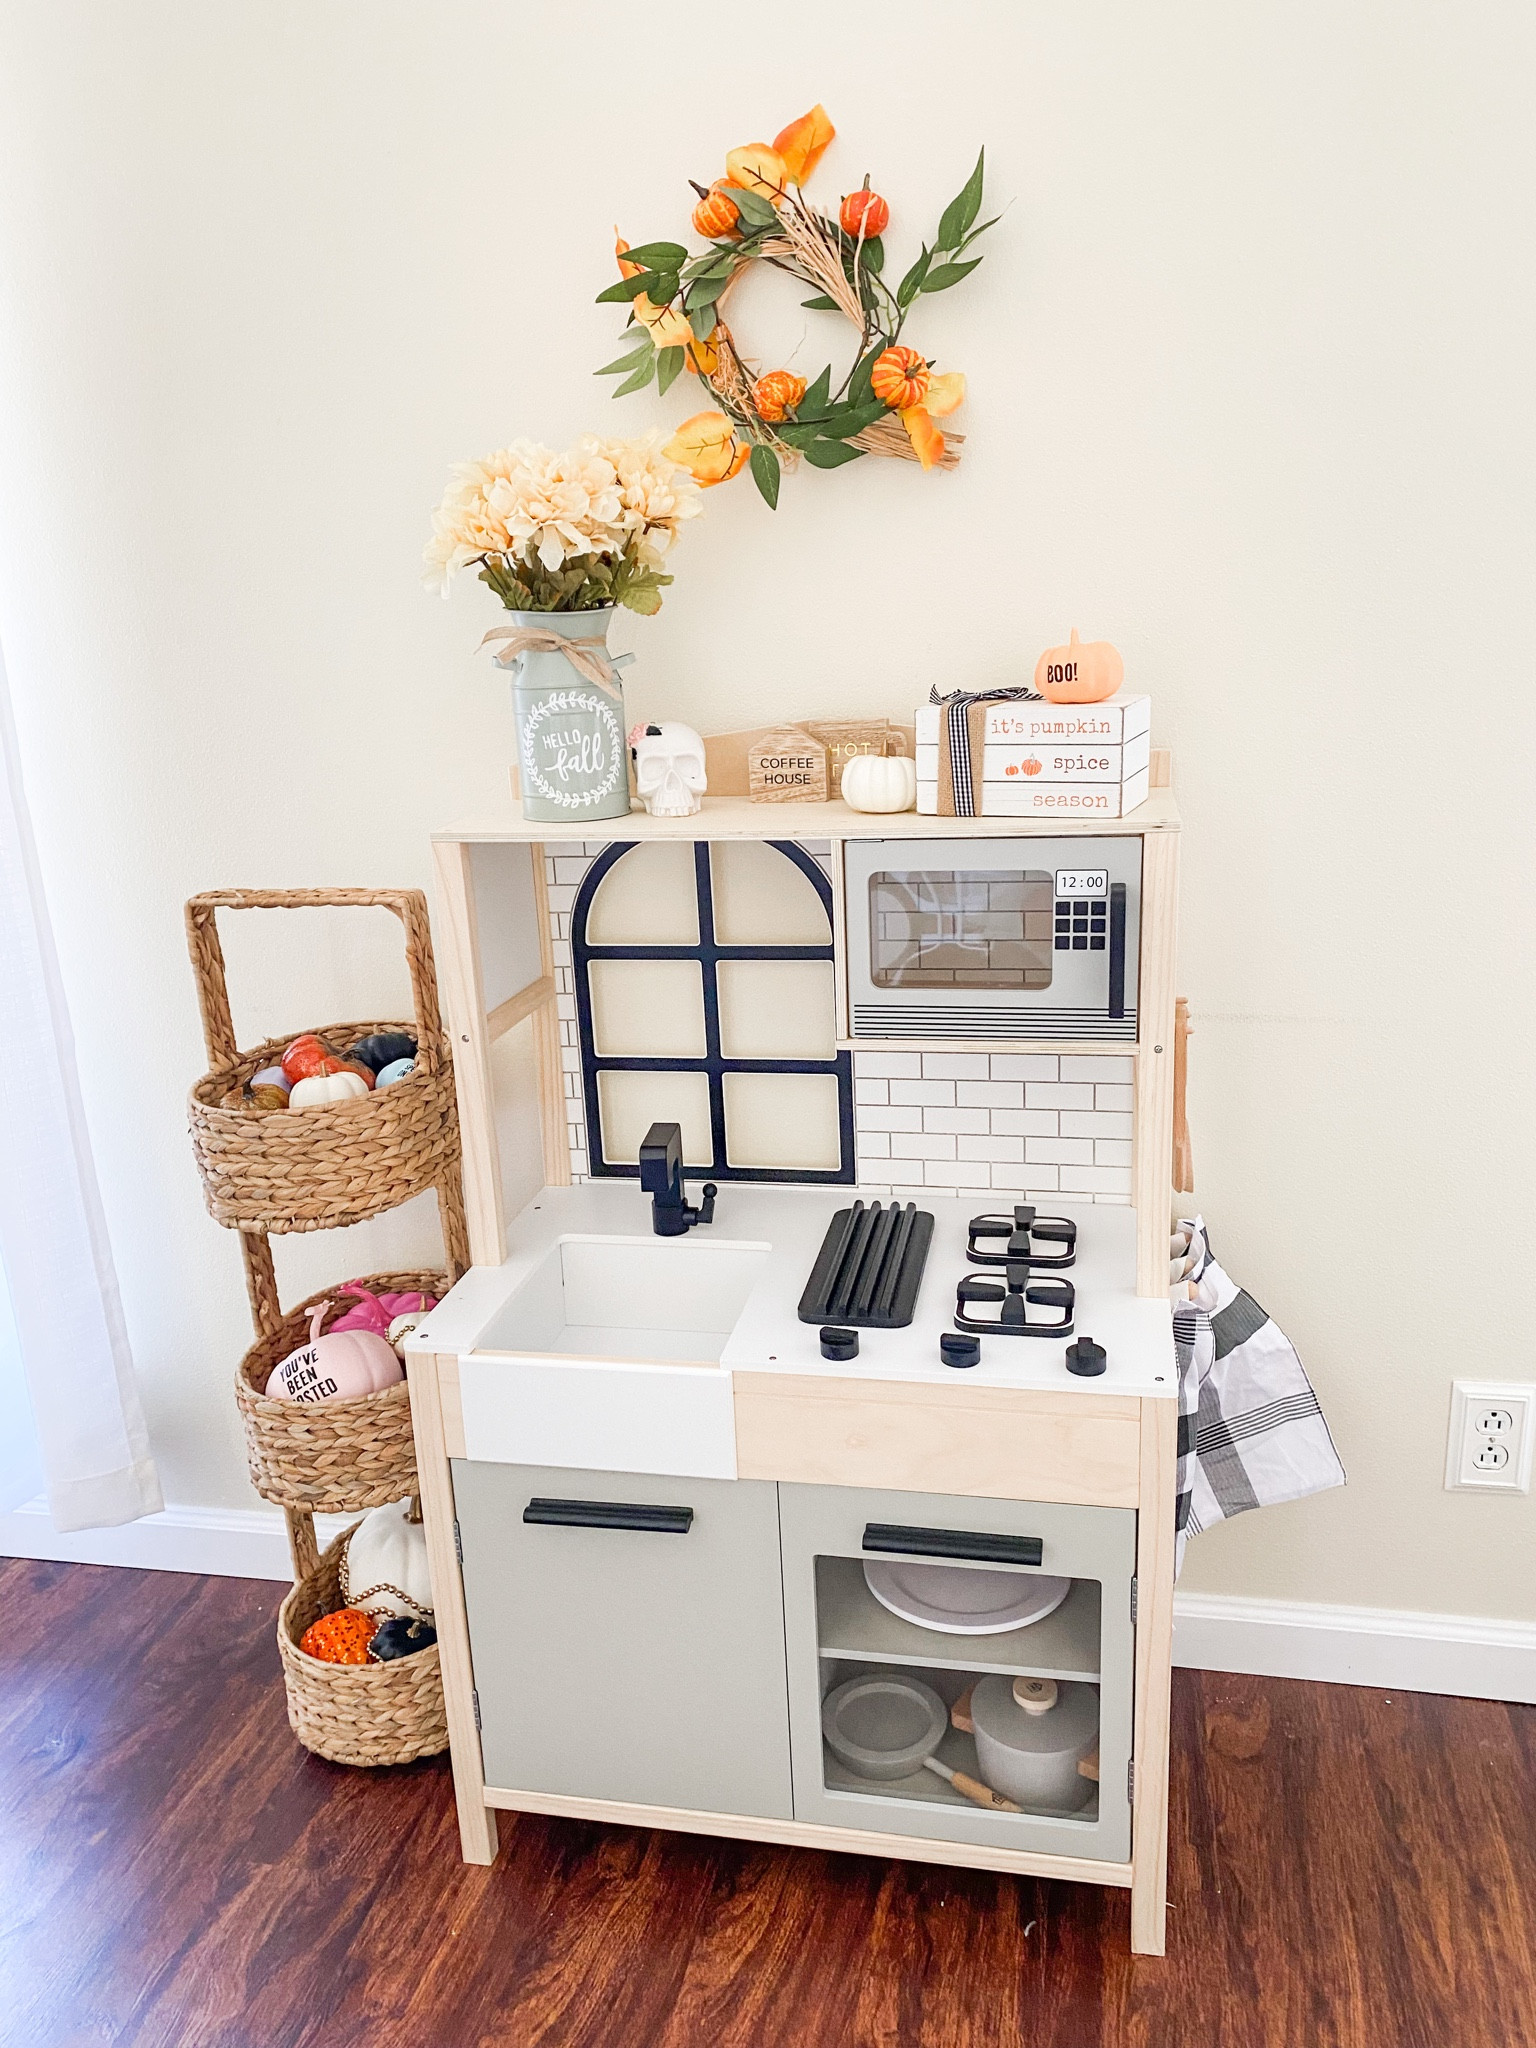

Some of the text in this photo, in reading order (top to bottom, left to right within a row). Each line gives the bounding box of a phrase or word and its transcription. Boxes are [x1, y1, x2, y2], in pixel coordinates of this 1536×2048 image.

[1047, 663, 1078, 684] BOO!
[991, 718, 1111, 737] it's pumpkin
[542, 729, 582, 750] HELLO
[545, 732, 605, 782] fall
[828, 742, 872, 758] HOT
[760, 758, 814, 769] COFFEE
[1053, 755, 1110, 773] spice
[764, 774, 811, 785] HOUSE
[1033, 795, 1109, 808] season
[280, 1348, 319, 1382] YOU'VE
[286, 1366, 318, 1395] BEEN
